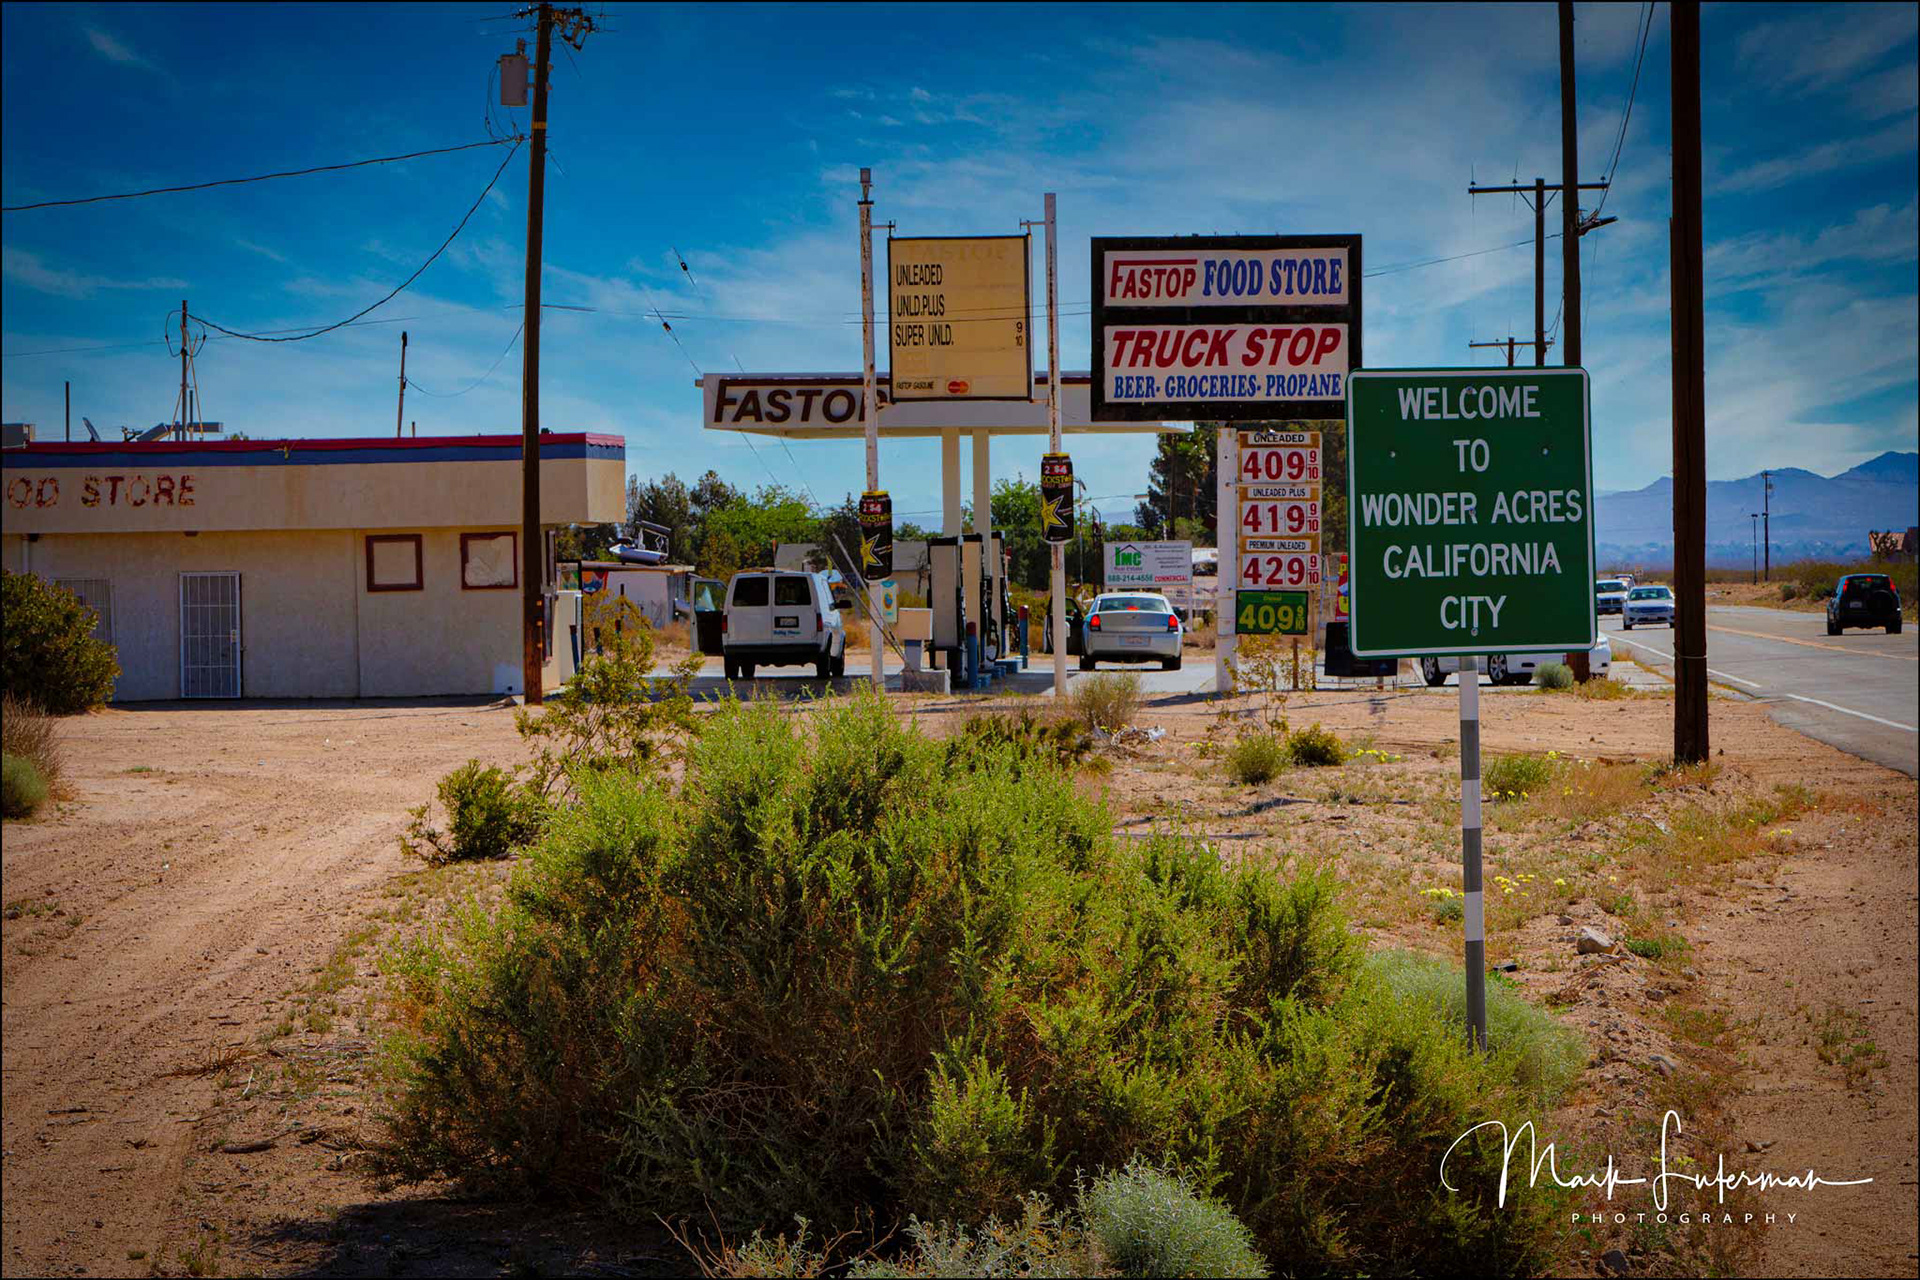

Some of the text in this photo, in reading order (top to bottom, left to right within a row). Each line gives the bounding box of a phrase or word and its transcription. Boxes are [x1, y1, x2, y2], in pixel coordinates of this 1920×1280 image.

[896, 264, 943, 286] UNLEADED
[1110, 258, 1342, 298] FASTOP FOOD STORE
[895, 323, 954, 346] SUPER UNLD.
[1111, 328, 1342, 368] TRUCK STOP
[1266, 373, 1341, 397] PROPANE
[1398, 385, 1541, 420] WELCOME
[1254, 434, 1305, 443] UNLEADED
[1243, 451, 1305, 480] 409
[1309, 450, 1317, 463] 9
[1453, 438, 1490, 472] TO
[1308, 466, 1319, 480] 10
[81, 475, 195, 507] STORE
[1253, 487, 1306, 497] UNLEADED PLUS
[1243, 504, 1305, 533] 419
[1309, 503, 1317, 516] 9
[1361, 489, 1582, 527] WONDER ACRES
[1308, 519, 1319, 532] 10
[1249, 541, 1306, 550] PREMIUM UNLEADED
[1243, 556, 1305, 585] 429
[1309, 555, 1317, 568] 9
[1383, 542, 1562, 578] CALIFORNIA
[1308, 571, 1319, 584] 10
[1239, 604, 1294, 630] 409
[1440, 594, 1507, 629] CITY
